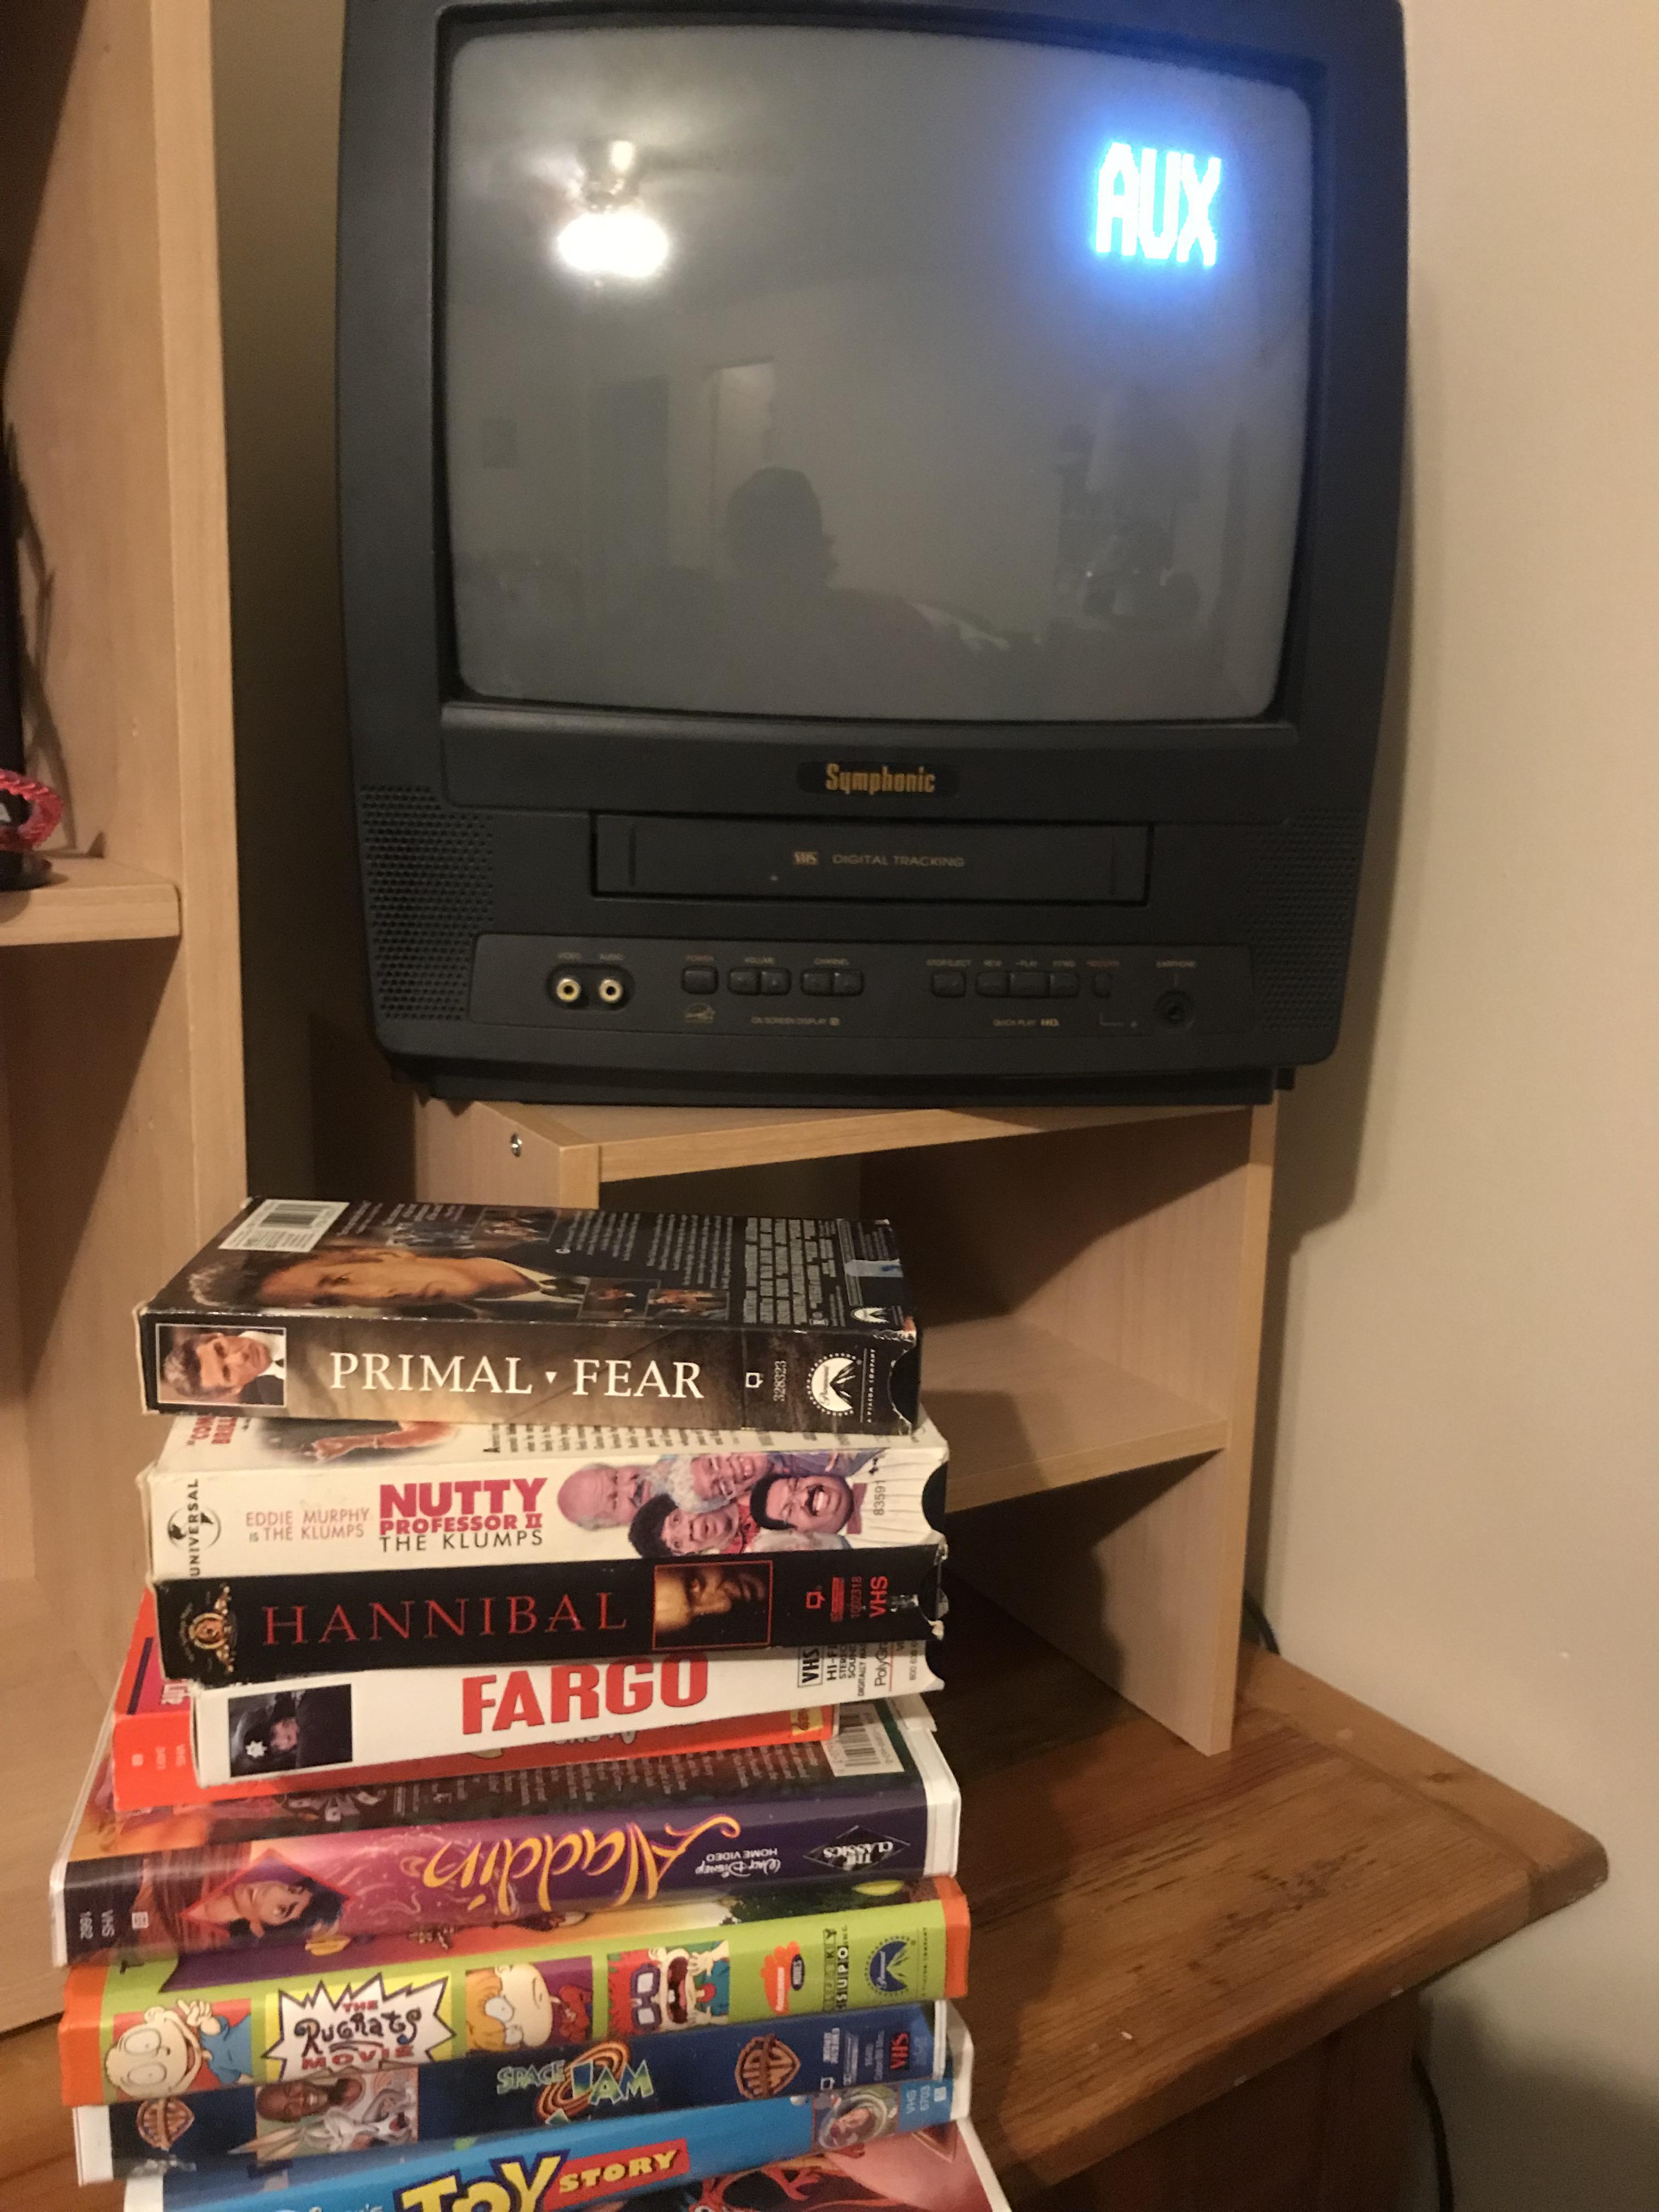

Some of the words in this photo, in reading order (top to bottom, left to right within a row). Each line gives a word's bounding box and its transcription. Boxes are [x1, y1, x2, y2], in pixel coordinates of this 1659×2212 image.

[1096, 142, 1222, 266] AUX
[826, 763, 935, 795] Symphonic
[831, 853, 889, 866] DIGITAL
[893, 855, 966, 868] TRACKING
[330, 1352, 532, 1395] PRIMAL
[572, 1358, 705, 1399] FEAR
[380, 1477, 548, 1519] NUTTY
[188, 1479, 201, 1578] UNIVERSAL
[246, 1510, 294, 1527] EDDIE
[303, 1507, 370, 1524] MURPHY
[264, 1527, 294, 1541] THE
[301, 1523, 365, 1541] KLUMPS
[380, 1516, 518, 1536] PROFESSOR
[525, 1513, 543, 1530] II
[380, 1534, 427, 1553] THE
[443, 1530, 543, 1550] KLUMPS
[869, 1576, 888, 1618] VHS
[262, 1592, 627, 1646] HANNIBAL
[802, 1647, 820, 1683] VHS
[462, 1652, 709, 1735] FARGO
[422, 1814, 741, 1915] Aladdin
[823, 1841, 894, 1859] CLASSICS
[101, 1909, 115, 1938] VHS
[343, 2000, 378, 2012] THE
[302, 2046, 415, 2070] MOVIE
[890, 2032, 910, 2070] VHS
[496, 2060, 567, 2094] SPACE
[548, 2058, 654, 2120] JAM
[402, 2157, 562, 2212] TOY
[559, 2149, 676, 2193] STORY
